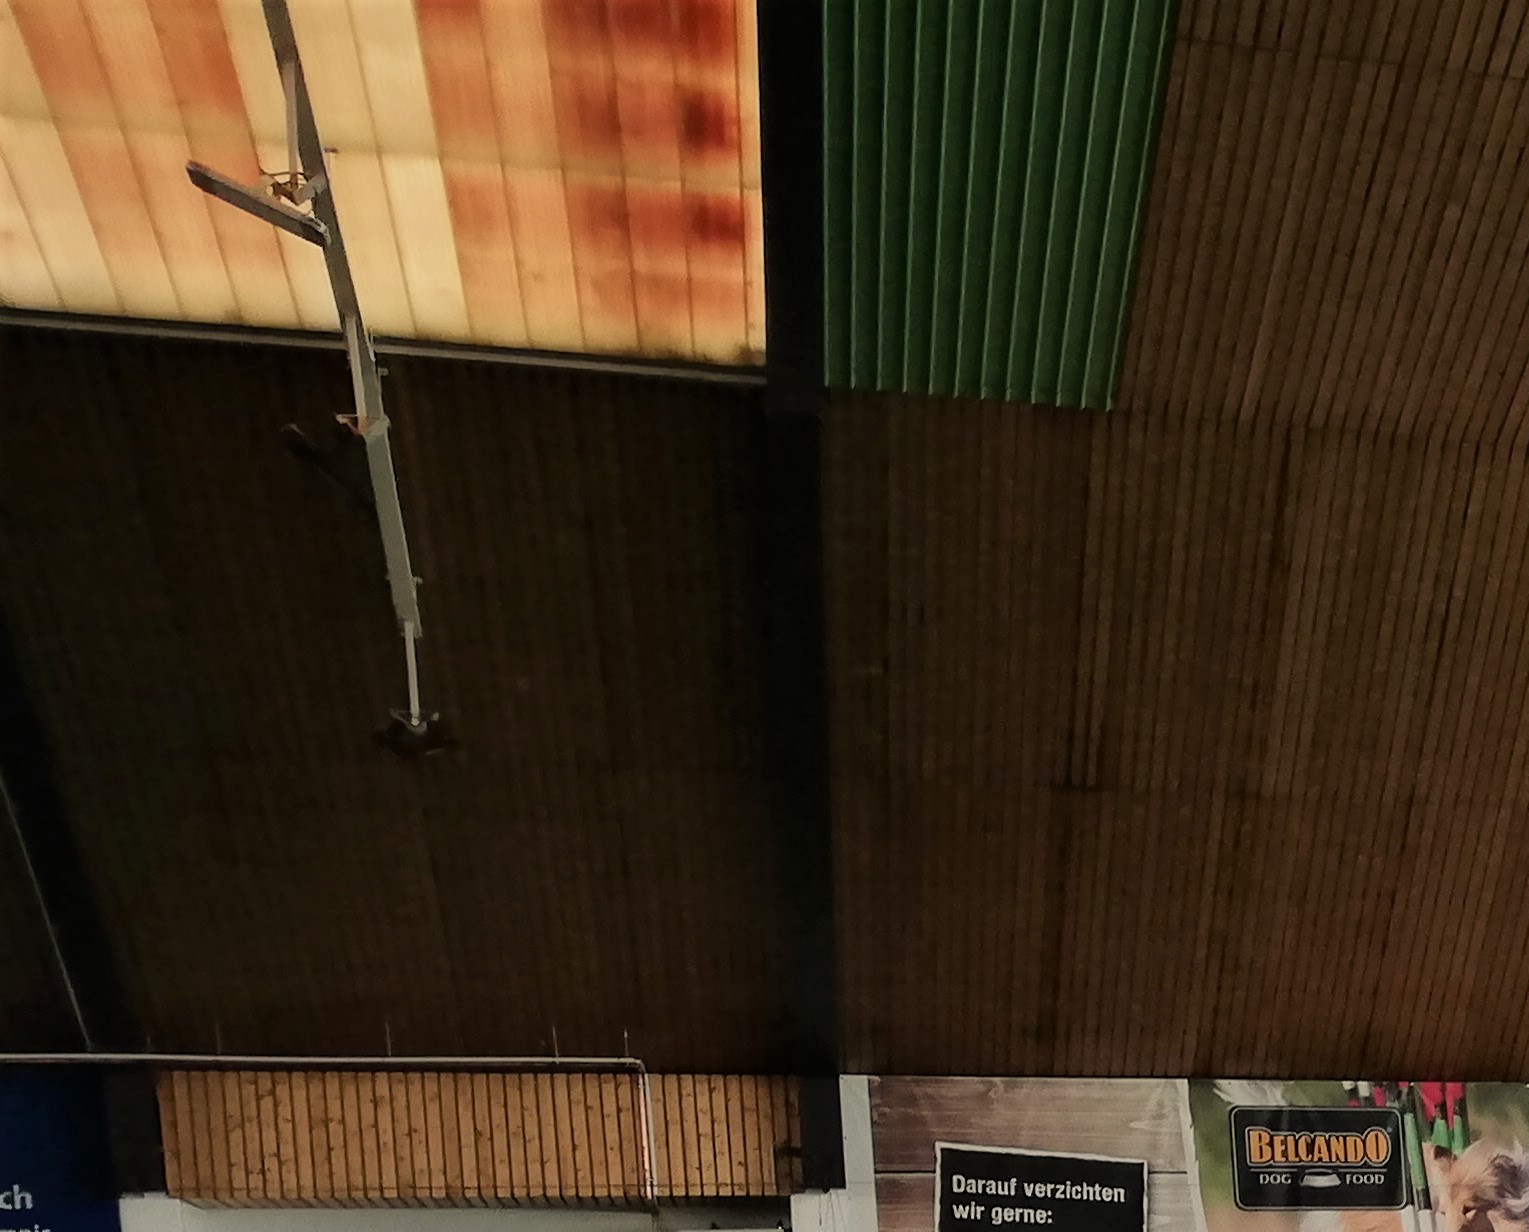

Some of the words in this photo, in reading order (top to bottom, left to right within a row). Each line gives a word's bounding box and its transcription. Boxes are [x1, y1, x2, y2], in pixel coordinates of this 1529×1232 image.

[1246, 1127, 1391, 1167] BELCANDO
[952, 1174, 1018, 1197] Darauf
[1023, 1181, 1126, 1203] verzichten
[1259, 1173, 1292, 1185] DOG
[1345, 1173, 1385, 1185] FOOD
[952, 1201, 985, 1220] wir
[991, 1206, 1053, 1225] gerne:
